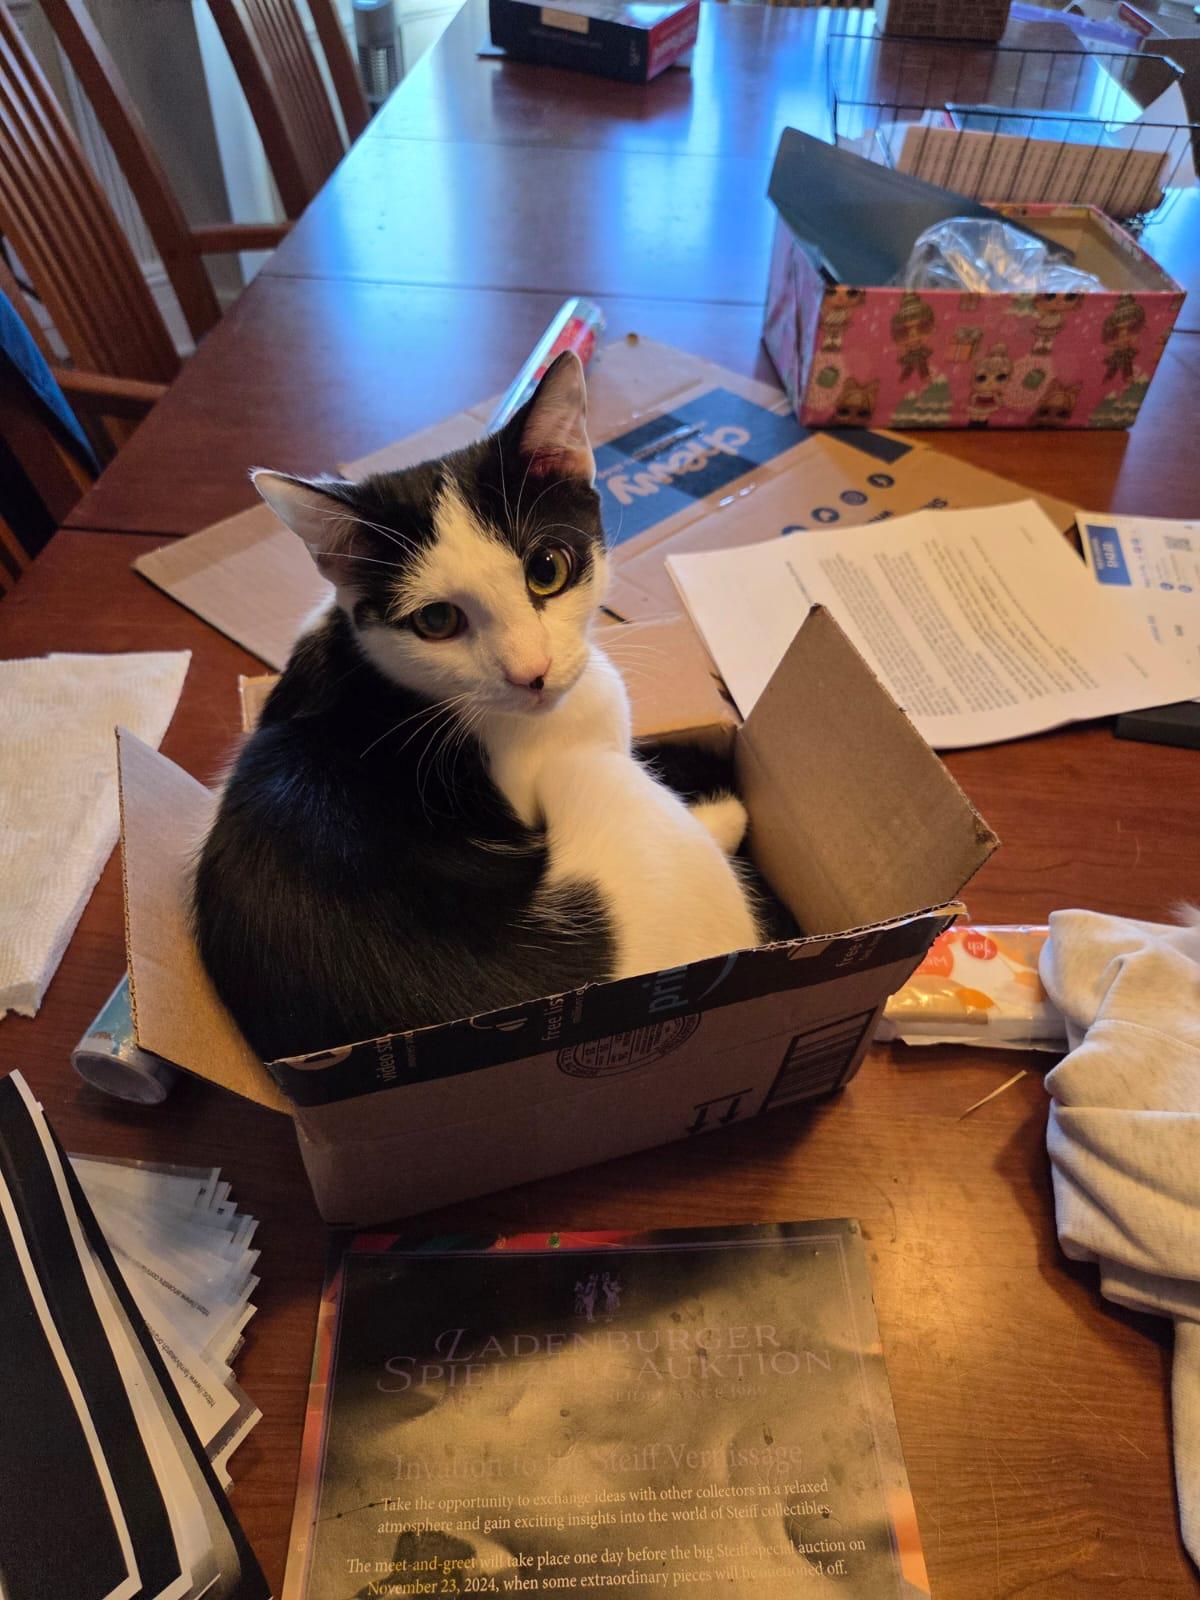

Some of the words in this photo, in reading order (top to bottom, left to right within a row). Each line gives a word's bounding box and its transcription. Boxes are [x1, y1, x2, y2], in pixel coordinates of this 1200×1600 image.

[607, 426, 751, 506] chewy
[541, 1015, 562, 1040] free
[376, 1054, 398, 1082] video
[434, 1324, 781, 1363] LADENBURGER
[597, 1441, 660, 1473] Steiff
[381, 1496, 411, 1511] Take
[415, 1496, 435, 1510] the
[438, 1494, 514, 1513] opportunity
[518, 1496, 529, 1506] to
[533, 1491, 591, 1508] exchange
[594, 1489, 626, 1502] ideas
[629, 1487, 657, 1501] with
[660, 1485, 693, 1500] other
[696, 1483, 755, 1499] collectors
[758, 1483, 771, 1496] in
[774, 1486, 781, 1495] a
[784, 1478, 829, 1495] relaxed
[377, 1517, 453, 1536] atmosphere
[456, 1516, 480, 1530] and
[483, 1516, 511, 1534] gain
[514, 1514, 565, 1530] exciting
[568, 1511, 617, 1528] insights
[620, 1510, 645, 1524] into
[648, 1508, 668, 1522] the
[671, 1506, 708, 1521] world
[711, 1505, 724, 1519] of
[726, 1503, 759, 1518] Steiff
[761, 1500, 833, 1517] collectibles.
[347, 1558, 372, 1573] The
[375, 1556, 476, 1575] meet-and-greet
[479, 1555, 504, 1569] will
[507, 1552, 534, 1568] take
[537, 1551, 571, 1570] place
[574, 1553, 597, 1564] one
[601, 1548, 626, 1567] day
[627, 1546, 667, 1562] before
[670, 1545, 690, 1559] the
[693, 1544, 715, 1562] big
[716, 1542, 750, 1558] Steiff
[798, 1538, 846, 1554] auction
[849, 1539, 866, 1550] on
[367, 1581, 439, 1596] November
[441, 1578, 461, 1595] 23,
[464, 1577, 500, 1593] 2024,
[503, 1575, 538, 1590] when
[542, 1577, 577, 1589] some
[580, 1569, 670, 1588] extraordinary
[673, 1568, 712, 1585] pieces
[715, 1565, 741, 1580] will
[827, 1559, 848, 1575] off.
